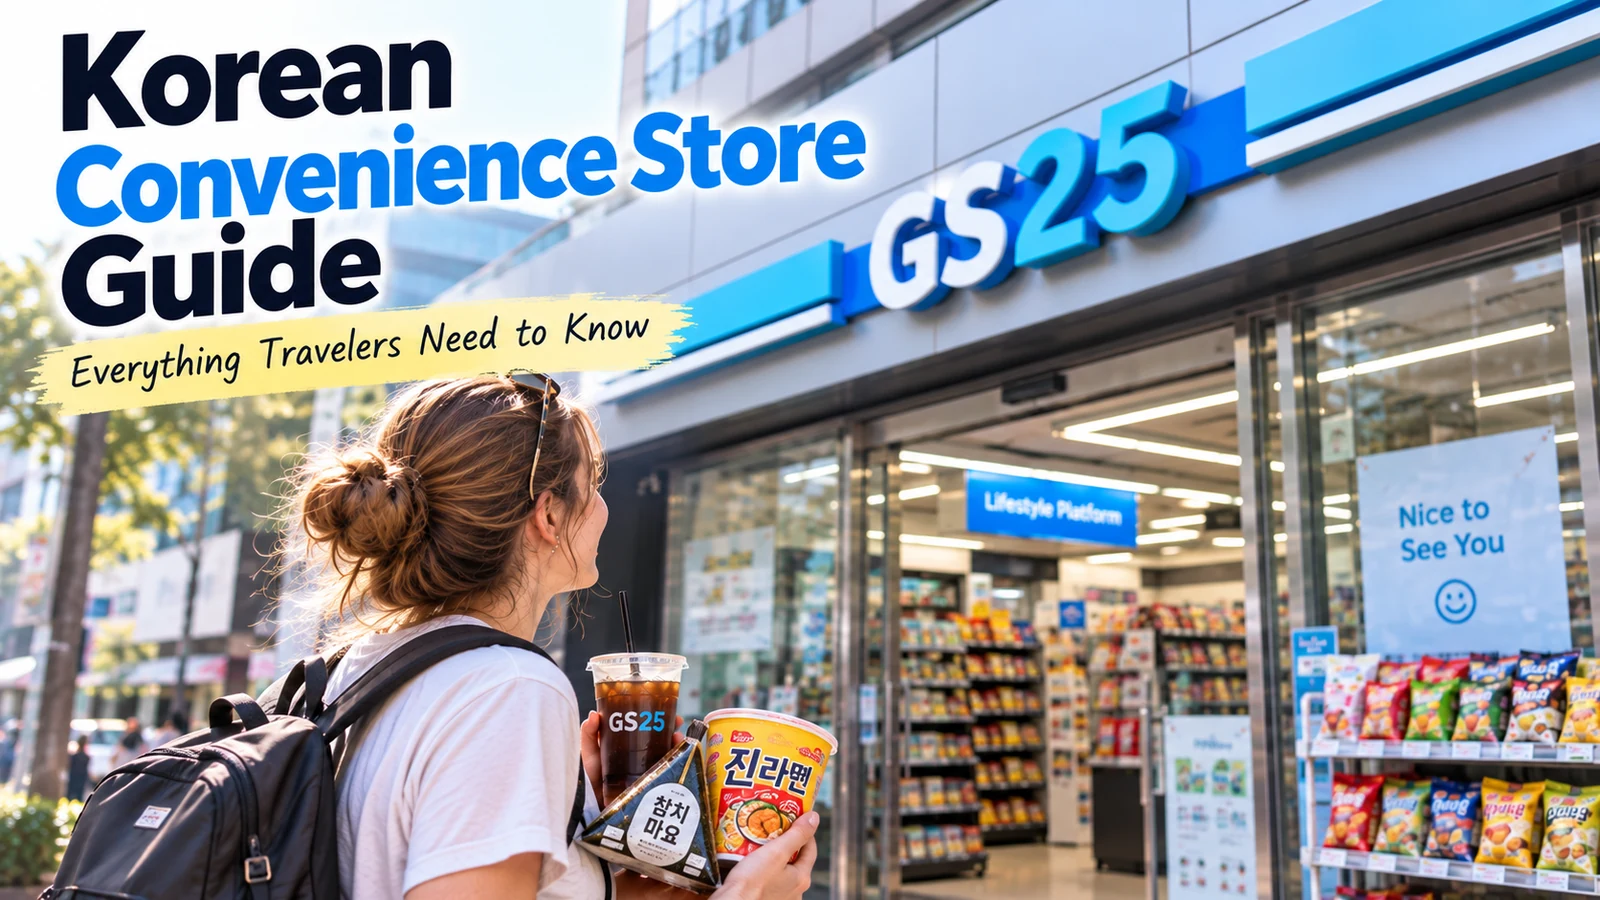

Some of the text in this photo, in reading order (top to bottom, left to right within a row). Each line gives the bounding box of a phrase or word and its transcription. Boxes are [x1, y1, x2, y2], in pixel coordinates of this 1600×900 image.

[869, 80, 1189, 311] GS25
[984, 491, 1122, 526] Lifestyle Platform
[1399, 498, 1490, 528] Nice to
[1401, 532, 1505, 562] See You
[608, 711, 665, 732] GS25
[653, 795, 691, 825] 참치
[643, 817, 680, 846] 마요
